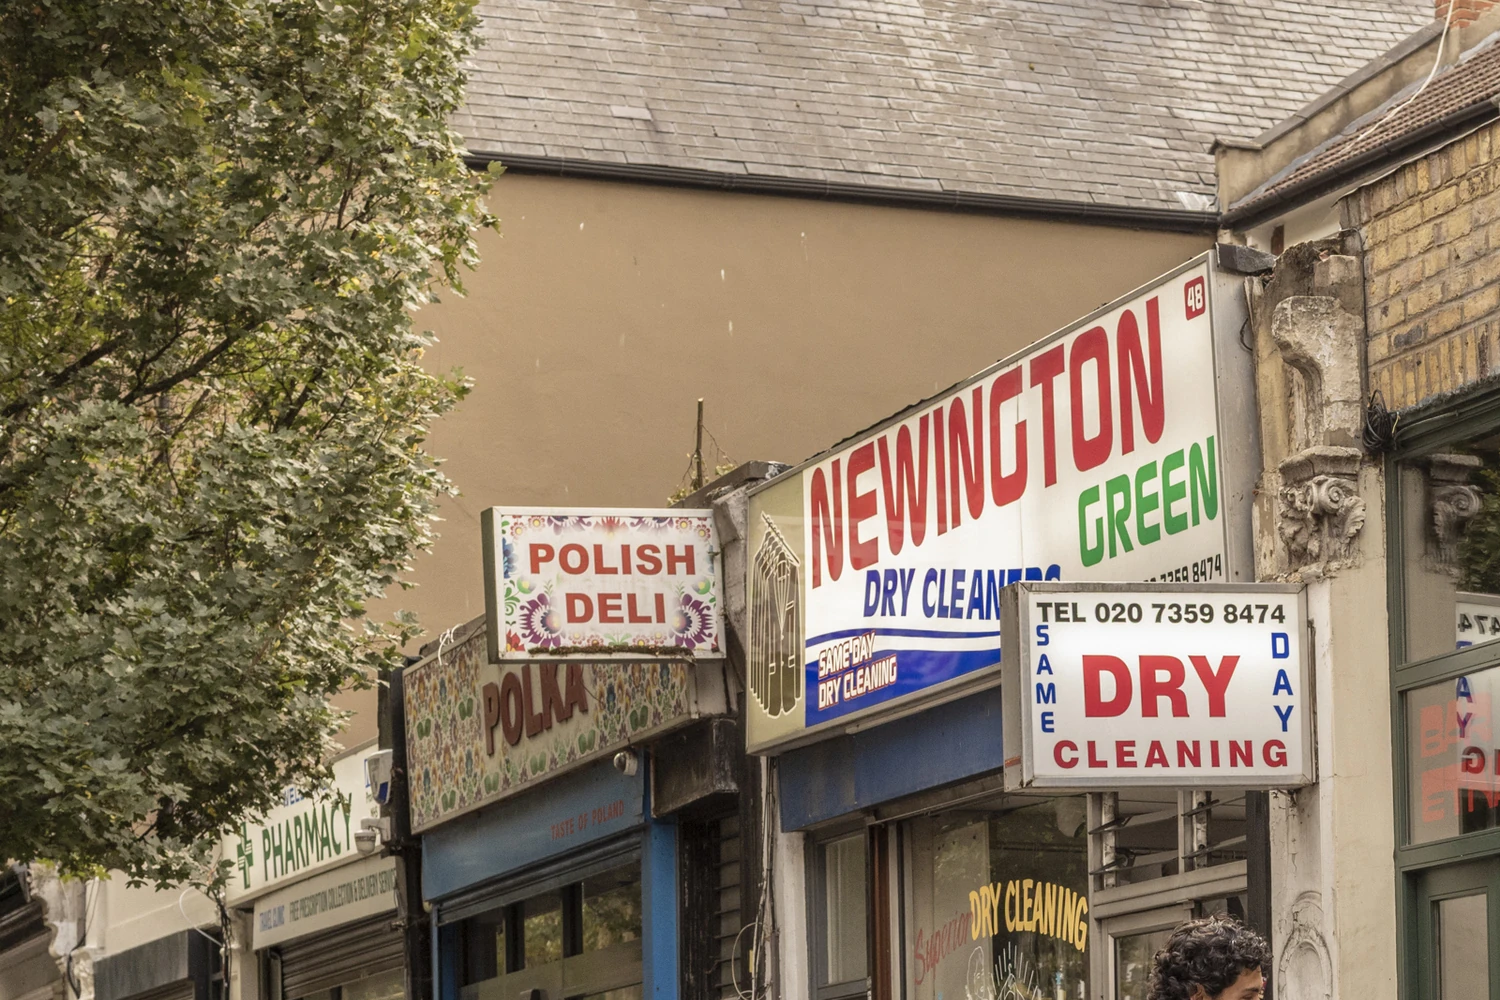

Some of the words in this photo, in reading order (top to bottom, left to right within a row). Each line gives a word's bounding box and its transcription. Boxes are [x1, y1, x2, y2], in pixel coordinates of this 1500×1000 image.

[1187, 283, 1203, 312] 48
[810, 296, 1165, 590] NEWINGTON
[1078, 435, 1218, 568] GREEN
[529, 543, 696, 575] POLISH
[1192, 553, 1222, 582] 8474
[565, 593, 666, 624] DELI
[863, 568, 916, 617] DRY
[922, 564, 1061, 620] CLEAN
[1036, 602, 1086, 622] TEL
[1095, 603, 1143, 623] 020
[1152, 603, 1214, 624] 7359
[1223, 604, 1286, 624] 8474
[818, 640, 850, 679] SAME
[852, 630, 876, 667] DAY
[818, 674, 842, 711] DRY
[844, 653, 898, 702] CLEANING
[1036, 624, 1056, 733] SAME
[1271, 632, 1294, 732] DAY
[482, 664, 589, 756] POLKA
[1082, 654, 1241, 718] DRY
[1420, 691, 1493, 758] BAR
[1053, 739, 1288, 769] CLEANING
[262, 793, 352, 881] PHARMACY
[550, 817, 574, 840] TASTE
[578, 812, 588, 831] OF
[591, 799, 625, 826] POLAND
[914, 911, 973, 985] Superior
[969, 881, 1002, 941] DRY
[1004, 878, 1088, 952] CLEANING
